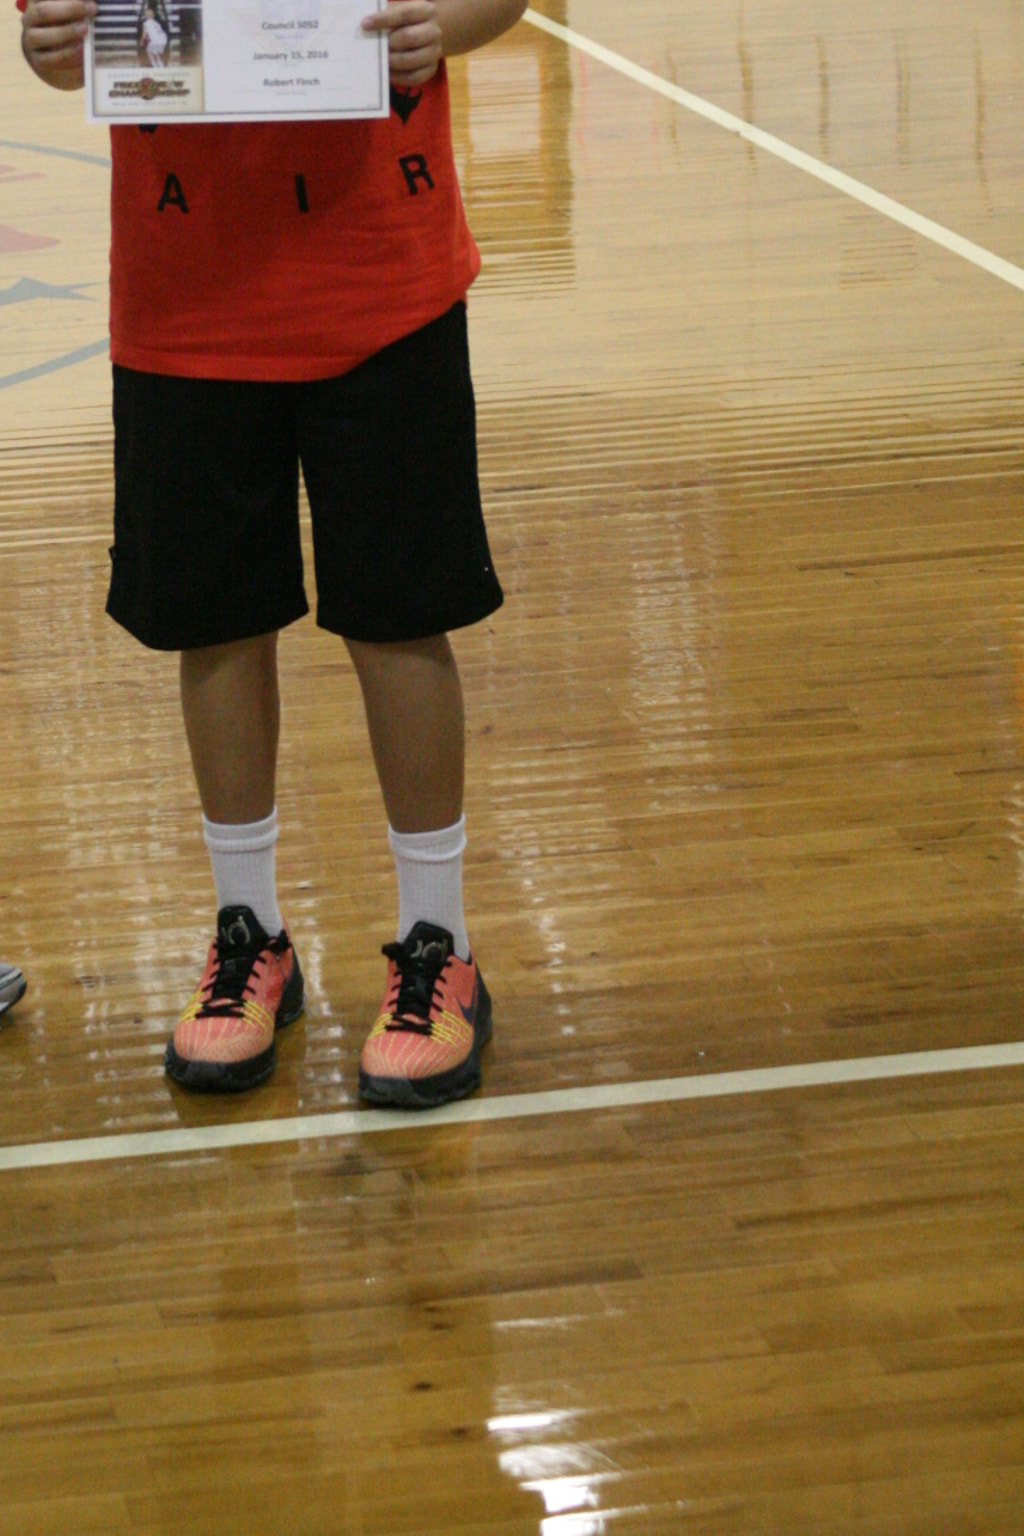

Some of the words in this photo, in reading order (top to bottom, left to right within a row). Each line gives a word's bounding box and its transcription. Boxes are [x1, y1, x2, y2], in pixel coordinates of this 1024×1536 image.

[261, 20, 295, 31] Council
[253, 52, 288, 62] January
[307, 49, 329, 59] 2016
[263, 78, 294, 87] Robert
[296, 77, 321, 86] Finch
